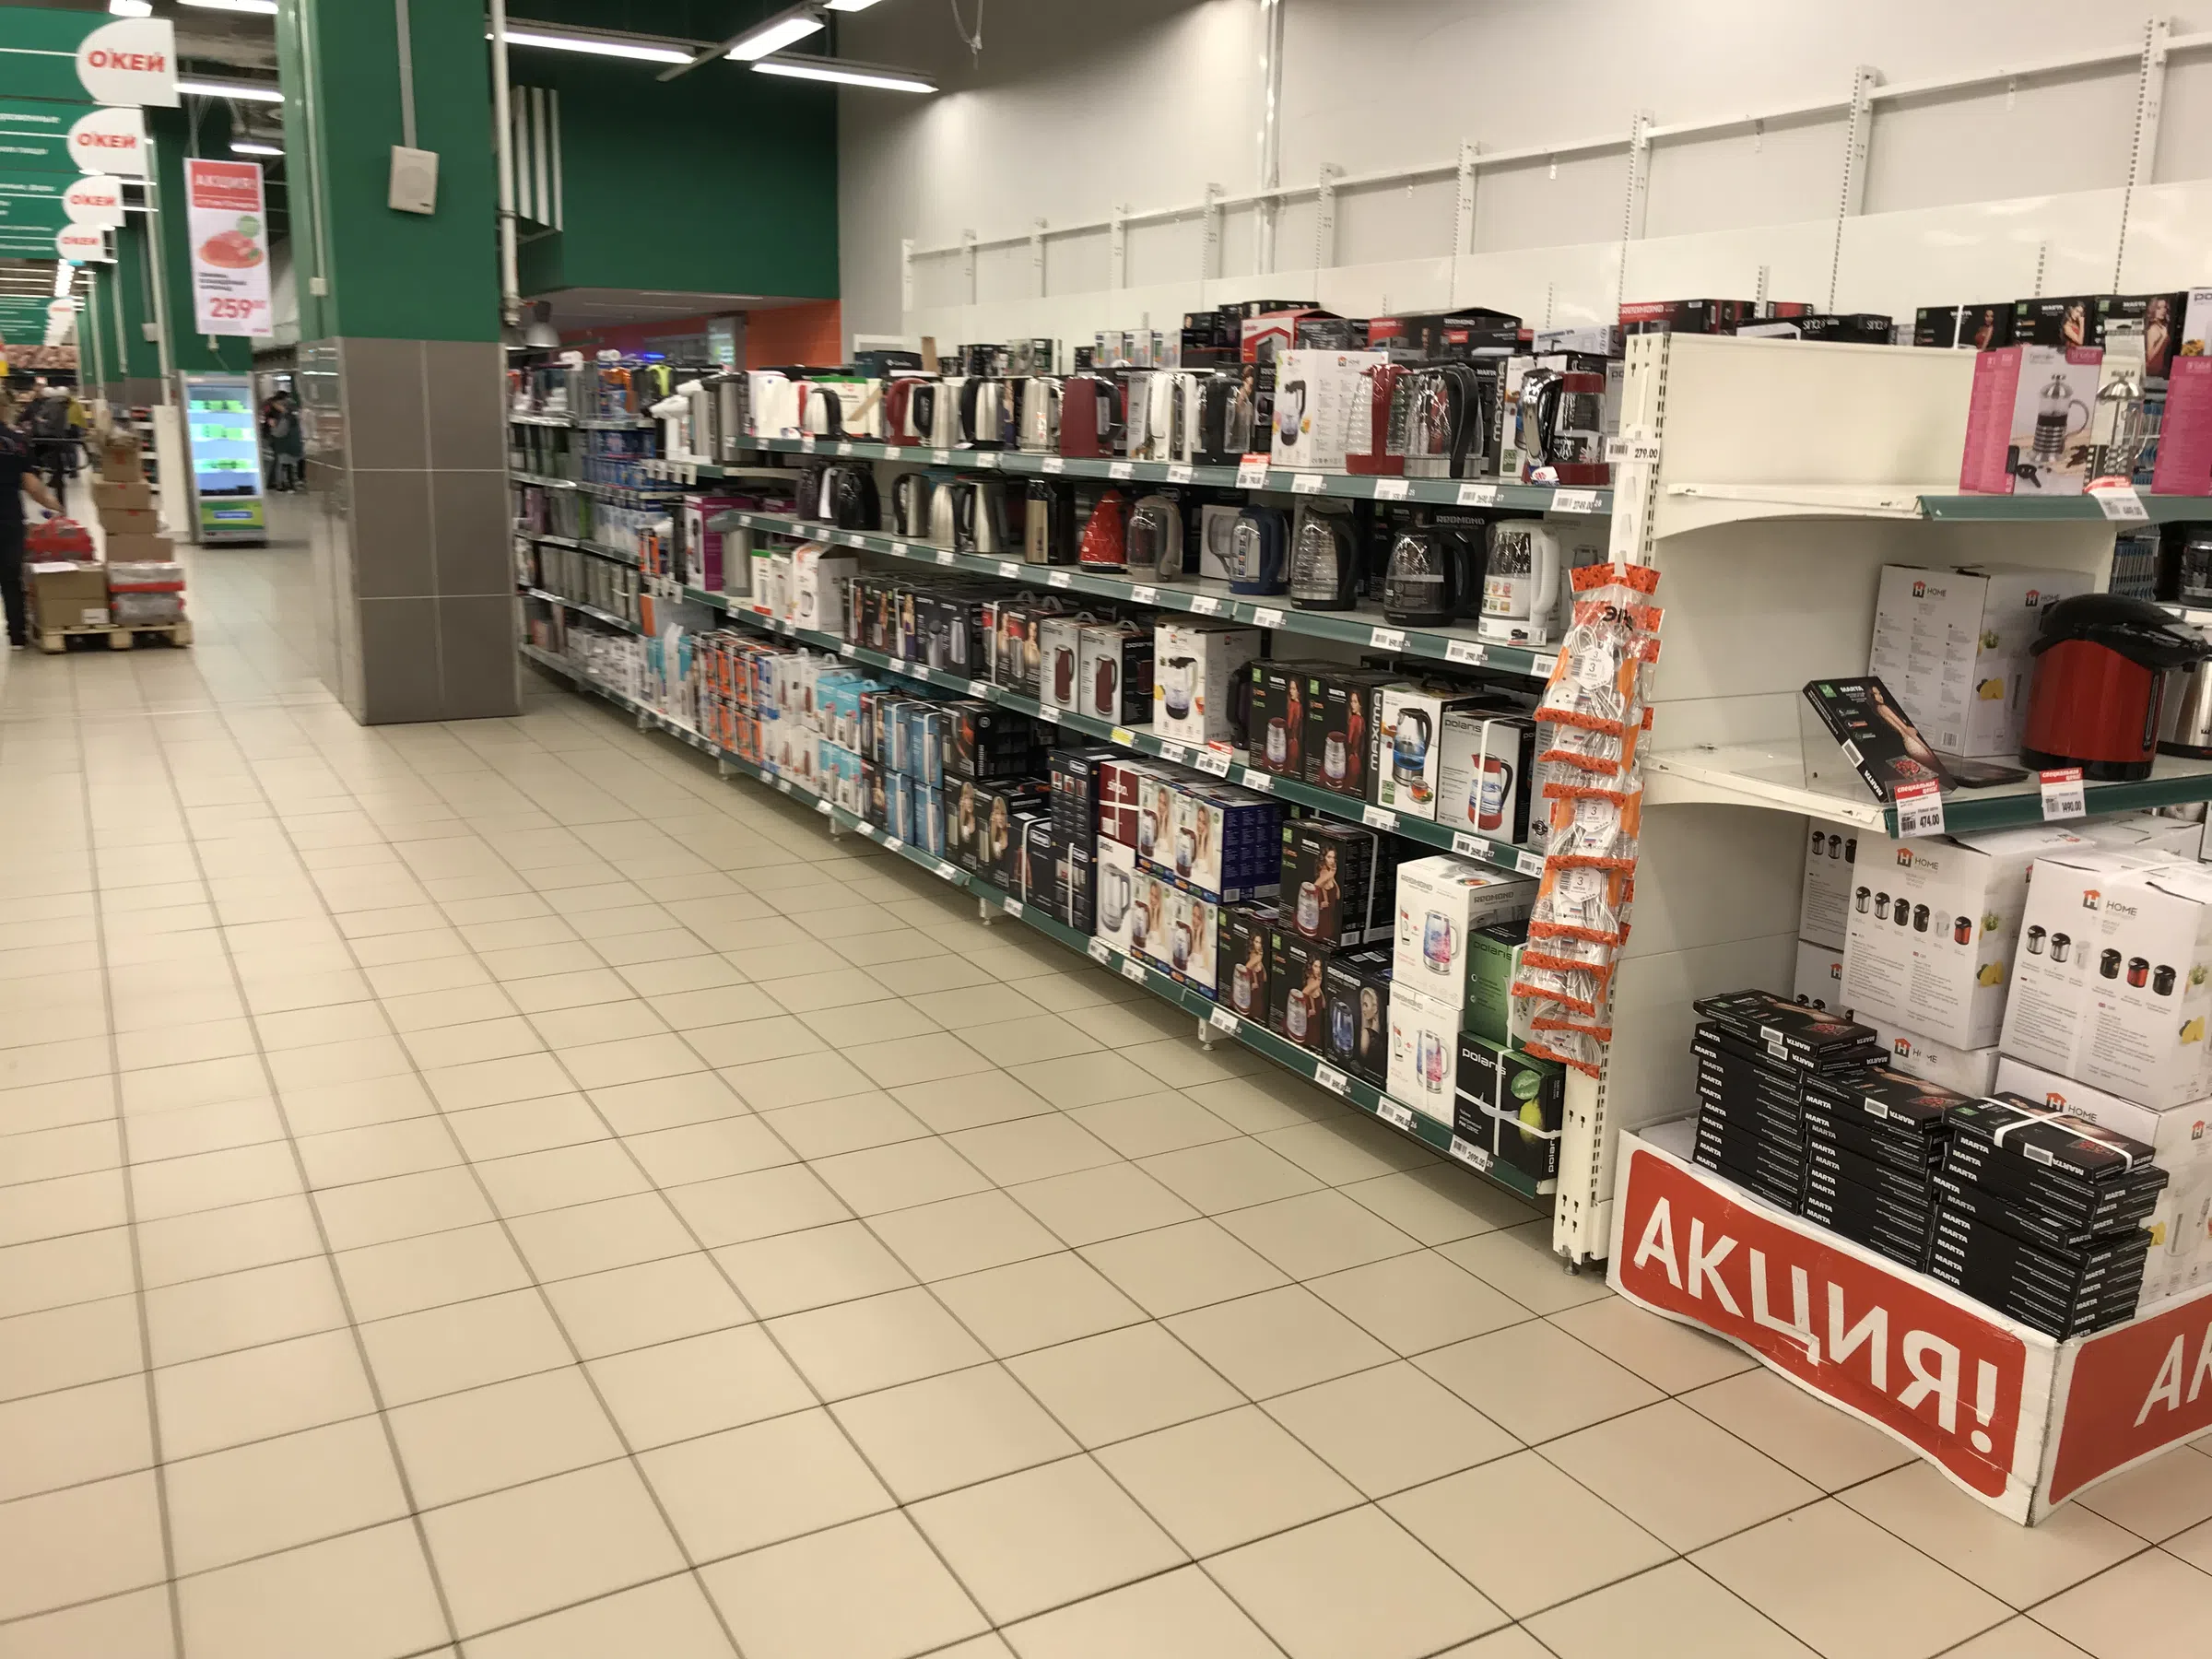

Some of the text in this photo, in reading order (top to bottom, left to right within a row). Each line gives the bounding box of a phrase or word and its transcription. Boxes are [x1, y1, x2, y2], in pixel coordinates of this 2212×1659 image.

[209, 297, 252, 319] 259
[1634, 448, 1658, 459] 279.00
[1436, 515, 1485, 525] REDMOND
[1926, 588, 1947, 597] HOME
[1840, 685, 1864, 693] MARTA
[1371, 691, 1382, 771] MAXIMA
[1444, 719, 1482, 733] polaris
[1864, 770, 1884, 796] MARTA
[1897, 781, 1936, 793] специальная
[1591, 806, 1597, 816] 3
[1920, 814, 1939, 828] 474.00
[1914, 856, 1938, 872] HOME
[1577, 877, 1583, 886] 3
[1474, 891, 1514, 904] REDMOND
[2106, 900, 2138, 916] HOME
[1474, 940, 1512, 960] polaris
[1699, 1029, 1721, 1042] MARTA
[1694, 1044, 1717, 1059] MARTA
[1786, 1037, 1810, 1052] MARTA
[1702, 1059, 1724, 1074] MARTA
[1792, 1053, 1814, 1068] MARTA
[1700, 1073, 1723, 1087] MARTA
[1700, 1086, 1722, 1100] MARTA
[1705, 1102, 1726, 1117] MARTA
[1806, 1095, 1831, 1110] MARTA
[1805, 1112, 1830, 1127] MARTA
[1889, 1111, 1915, 1126] MARTA
[2067, 1104, 2097, 1122] HOME
[1702, 1116, 1724, 1131] MARTA
[1700, 1129, 1722, 1144] MARTA
[1812, 1124, 1836, 1139] MARTA
[1700, 1142, 1722, 1157] MARTA
[1811, 1141, 1835, 1156] MARTA
[1960, 1136, 1989, 1154] MARTA
[1696, 1155, 1718, 1170] MARTA
[1816, 1156, 1840, 1171] MARTA
[1952, 1149, 1982, 1167] MARTA
[1948, 1163, 1978, 1182] MARTA
[2053, 1159, 2084, 1176] MARTA
[1811, 1169, 1835, 1184] MARTA
[1811, 1181, 1835, 1196] MARTA
[1933, 1175, 1960, 1194] MARTA
[2104, 1189, 2126, 1200] MARTA
[1808, 1197, 1832, 1212] MARTA
[1947, 1194, 1976, 1213] MARTA
[2097, 1203, 2117, 1215] MARTA
[1806, 1209, 1830, 1225] MARTA
[1942, 1211, 1971, 1230] MARTA
[2092, 1218, 2113, 1230] MARTA
[1939, 1225, 1968, 1243] MARTA
[2069, 1233, 2092, 1244] MARTA
[1937, 1239, 1965, 1257] MARTA
[1935, 1253, 1963, 1272] MARTA
[2091, 1252, 2112, 1264] MARTA
[1933, 1266, 1960, 1286] MARTA
[2085, 1267, 2106, 1280] MARTA
[2079, 1283, 2101, 1295] MARTA
[2077, 1298, 2098, 1311] MARTA
[1632, 1196, 1998, 1454] АКЦИЯ!
[2074, 1313, 2095, 1325] MARTA
